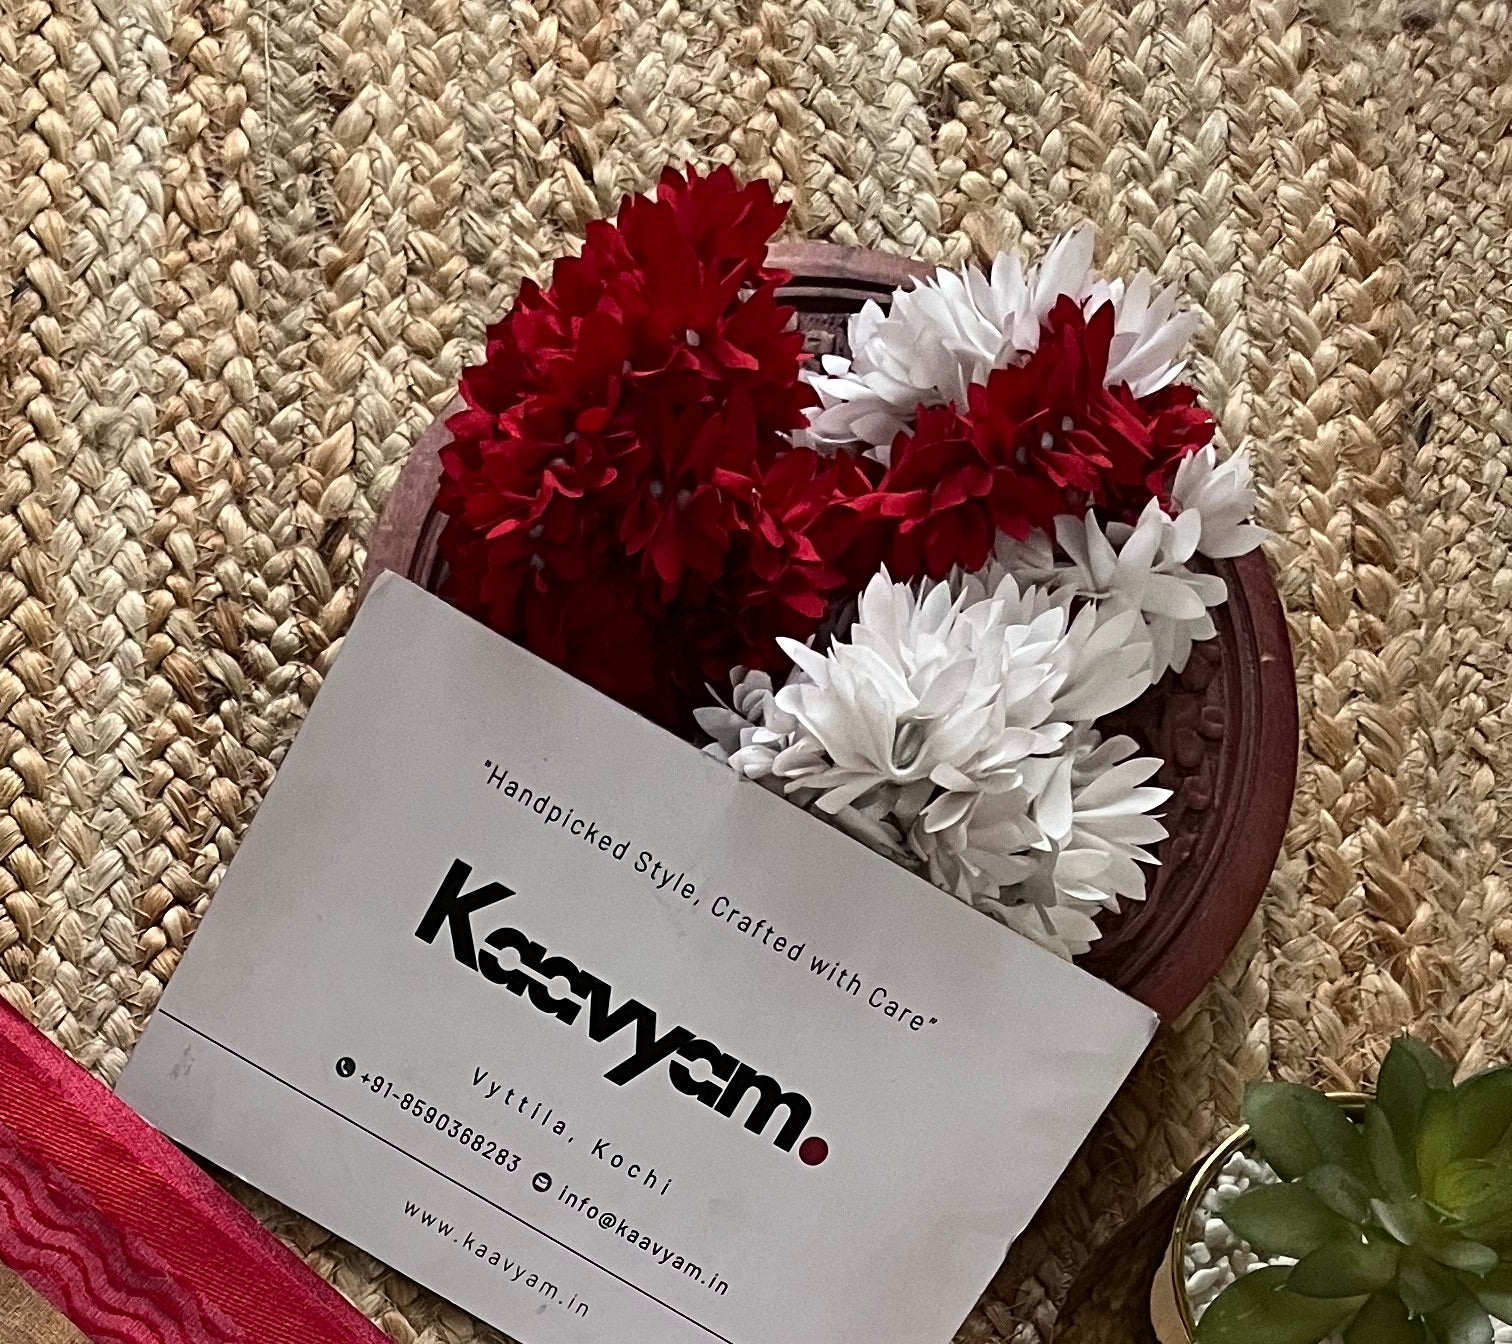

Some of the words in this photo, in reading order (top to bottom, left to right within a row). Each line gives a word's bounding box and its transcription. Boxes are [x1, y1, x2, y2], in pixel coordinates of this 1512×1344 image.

[484, 759, 632, 861] "Handpicked
[634, 851, 700, 906] Style,
[710, 896, 806, 961] Crafted
[810, 955, 862, 996] with
[414, 857, 829, 1167] Kaavyam.
[360, 1072, 522, 1173] +91-8590368283
[557, 1185, 730, 1296] info@kaavyam.in
[472, 1066, 574, 1143] Vyttila,
[590, 1138, 673, 1196] Kochi
[403, 1200, 589, 1318] www.kaavyam.in
